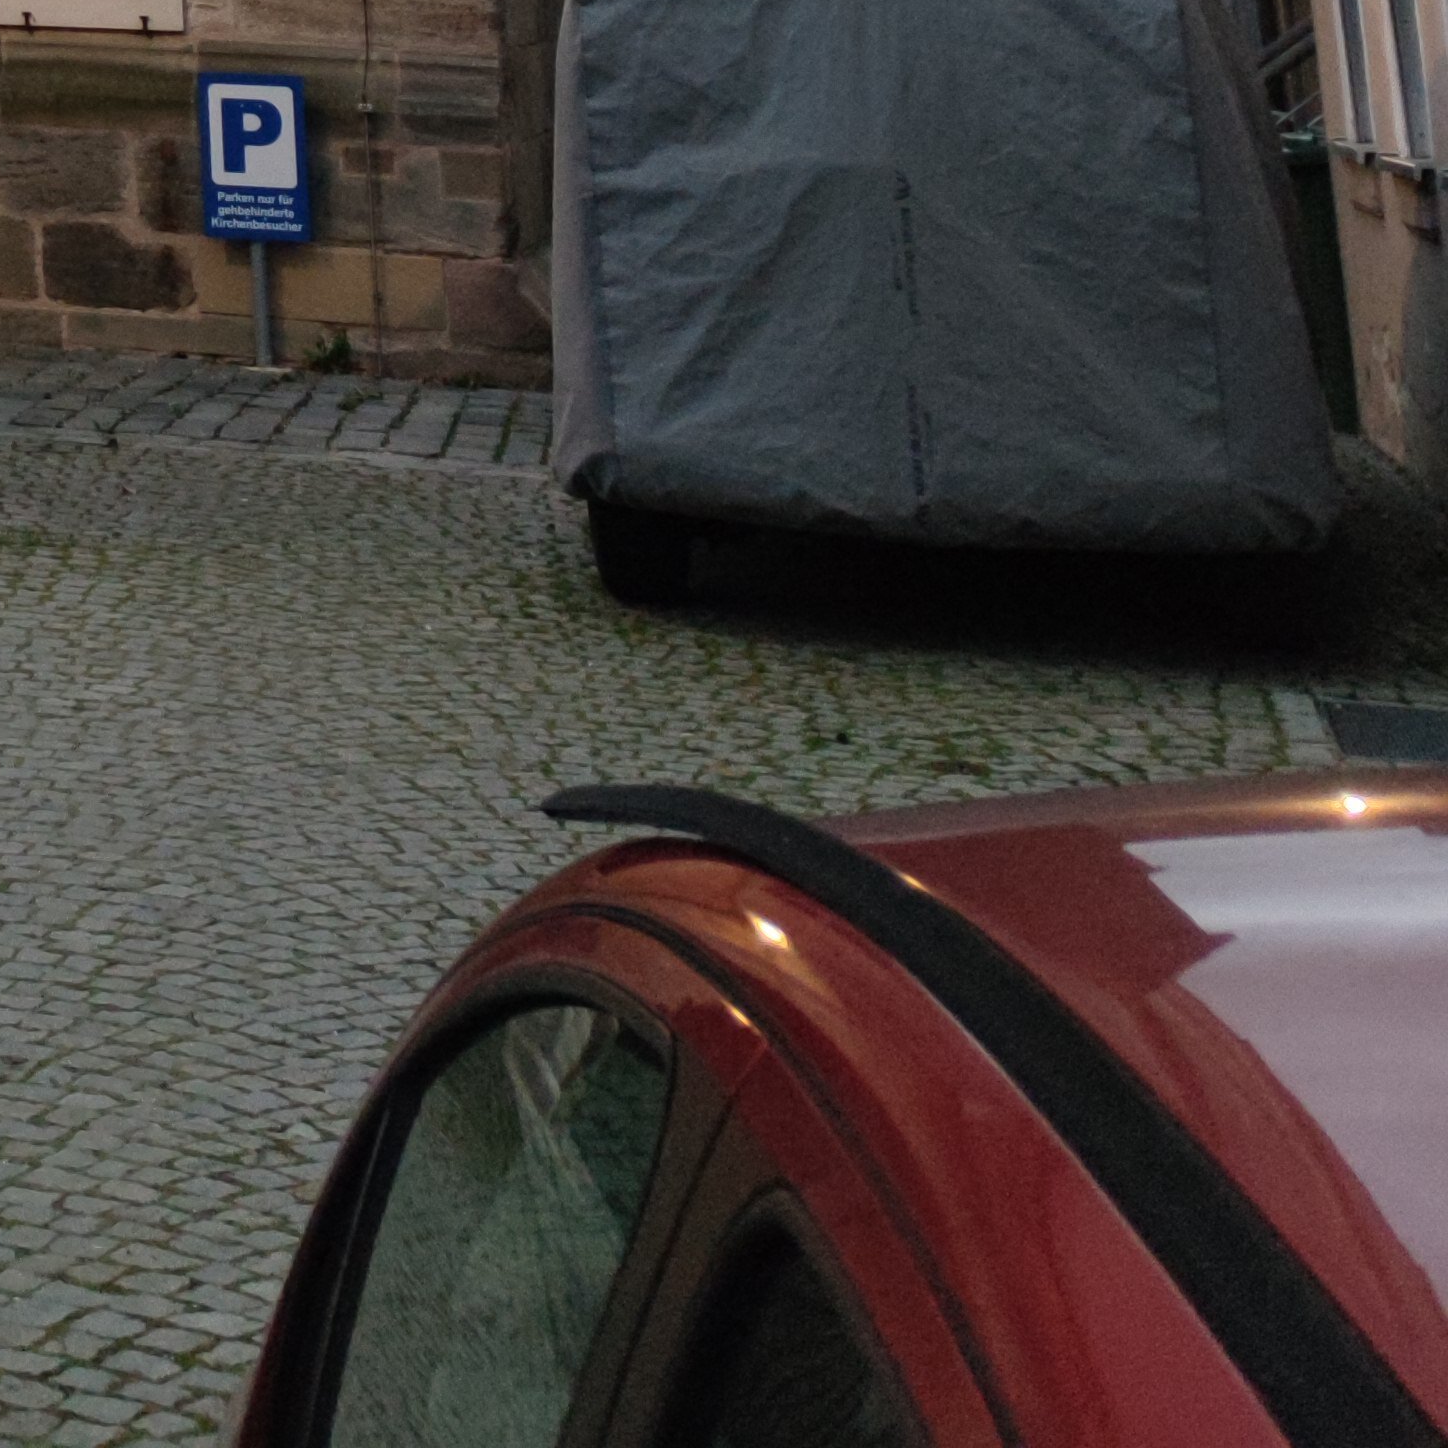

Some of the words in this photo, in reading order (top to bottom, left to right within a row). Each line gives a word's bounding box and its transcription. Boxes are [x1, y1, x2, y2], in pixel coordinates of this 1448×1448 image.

[221, 98, 282, 173] P
[217, 191, 254, 203] Parken
[257, 195, 275, 204] nur
[278, 194, 294, 205] für
[217, 205, 294, 219] gehbehinderte
[211, 216, 303, 232] Kirchenbesucher
